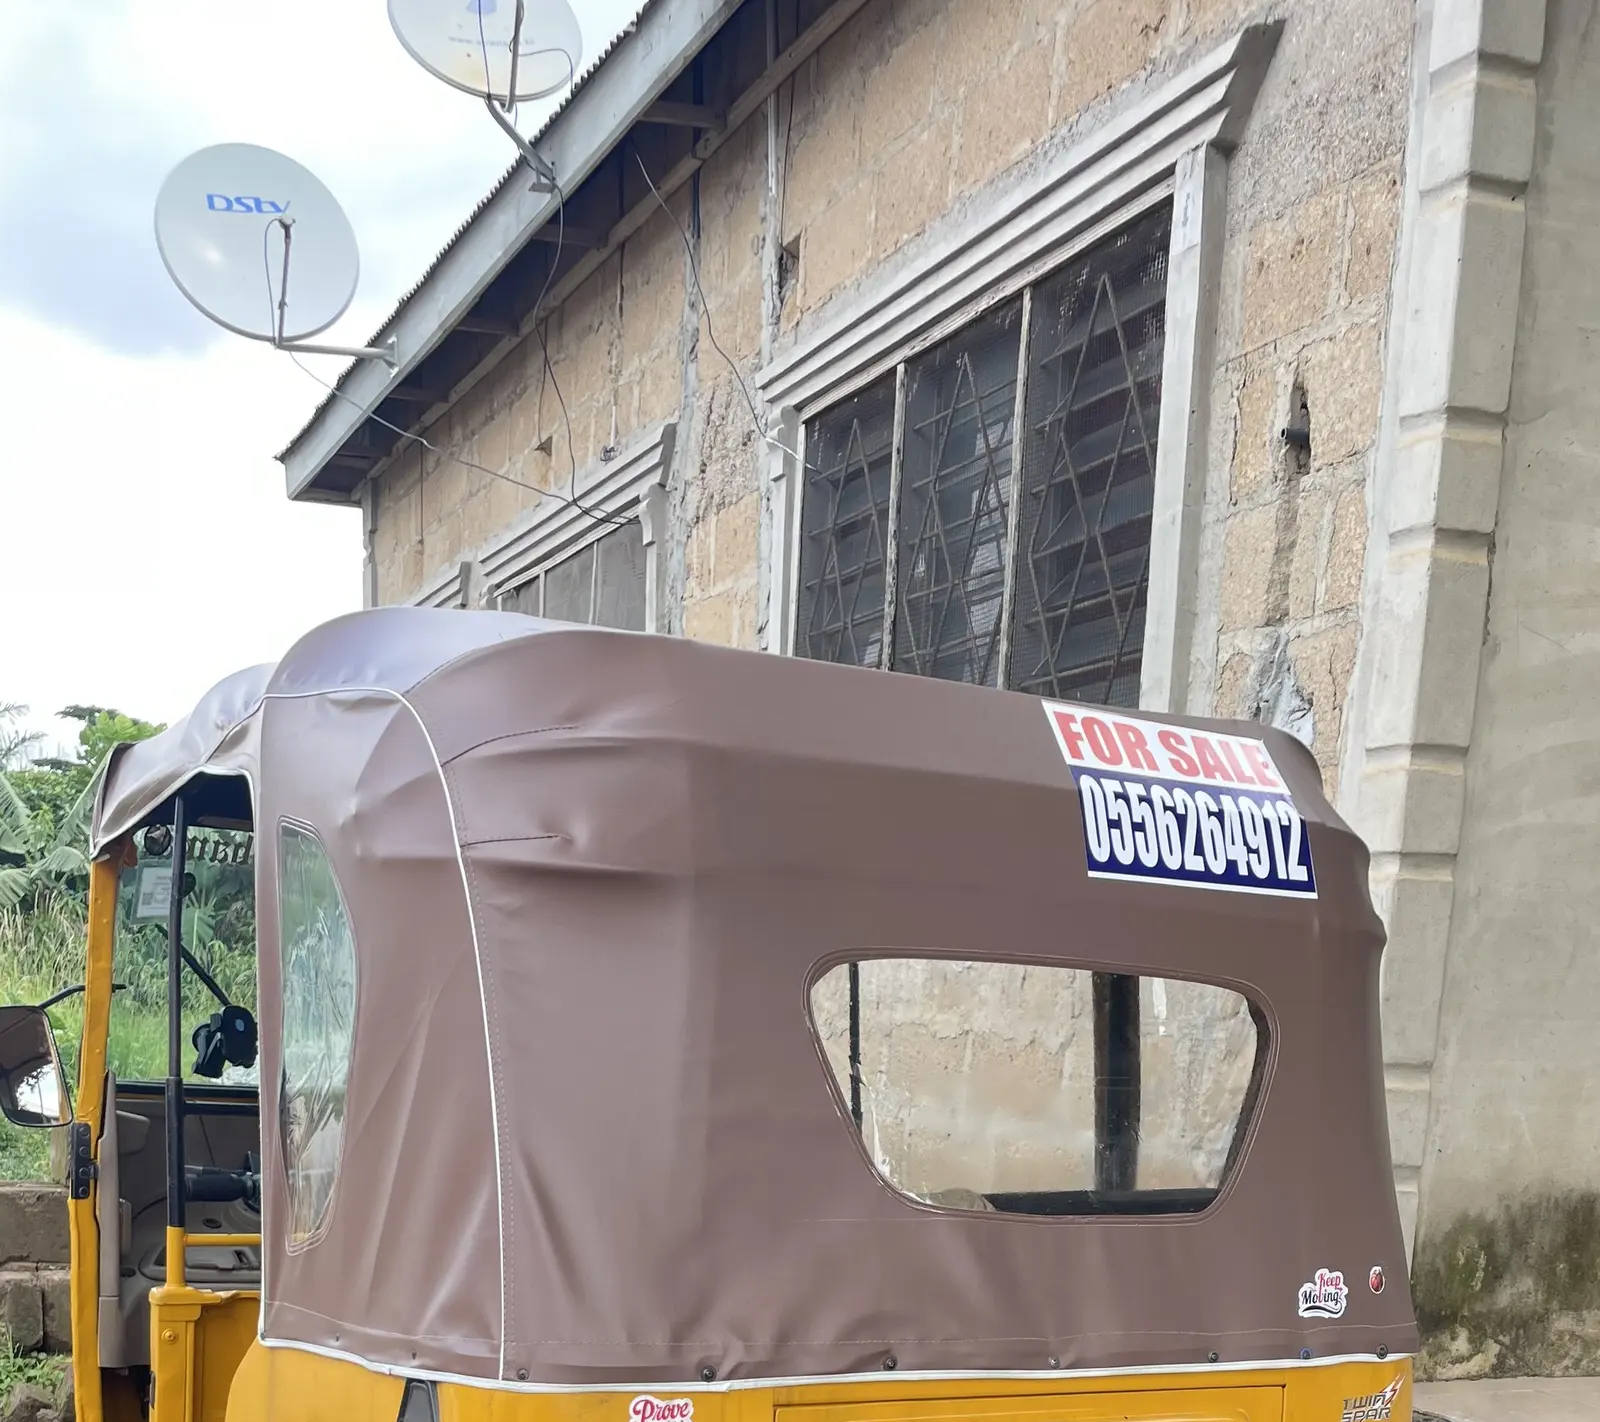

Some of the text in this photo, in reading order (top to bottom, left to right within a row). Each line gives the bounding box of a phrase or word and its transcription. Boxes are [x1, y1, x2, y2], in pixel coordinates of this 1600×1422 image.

[206, 193, 291, 215] DStv
[1053, 710, 1281, 787] FOR SALE
[1077, 773, 1310, 882] 0556264912
[1301, 1289, 1340, 1306] Moving
